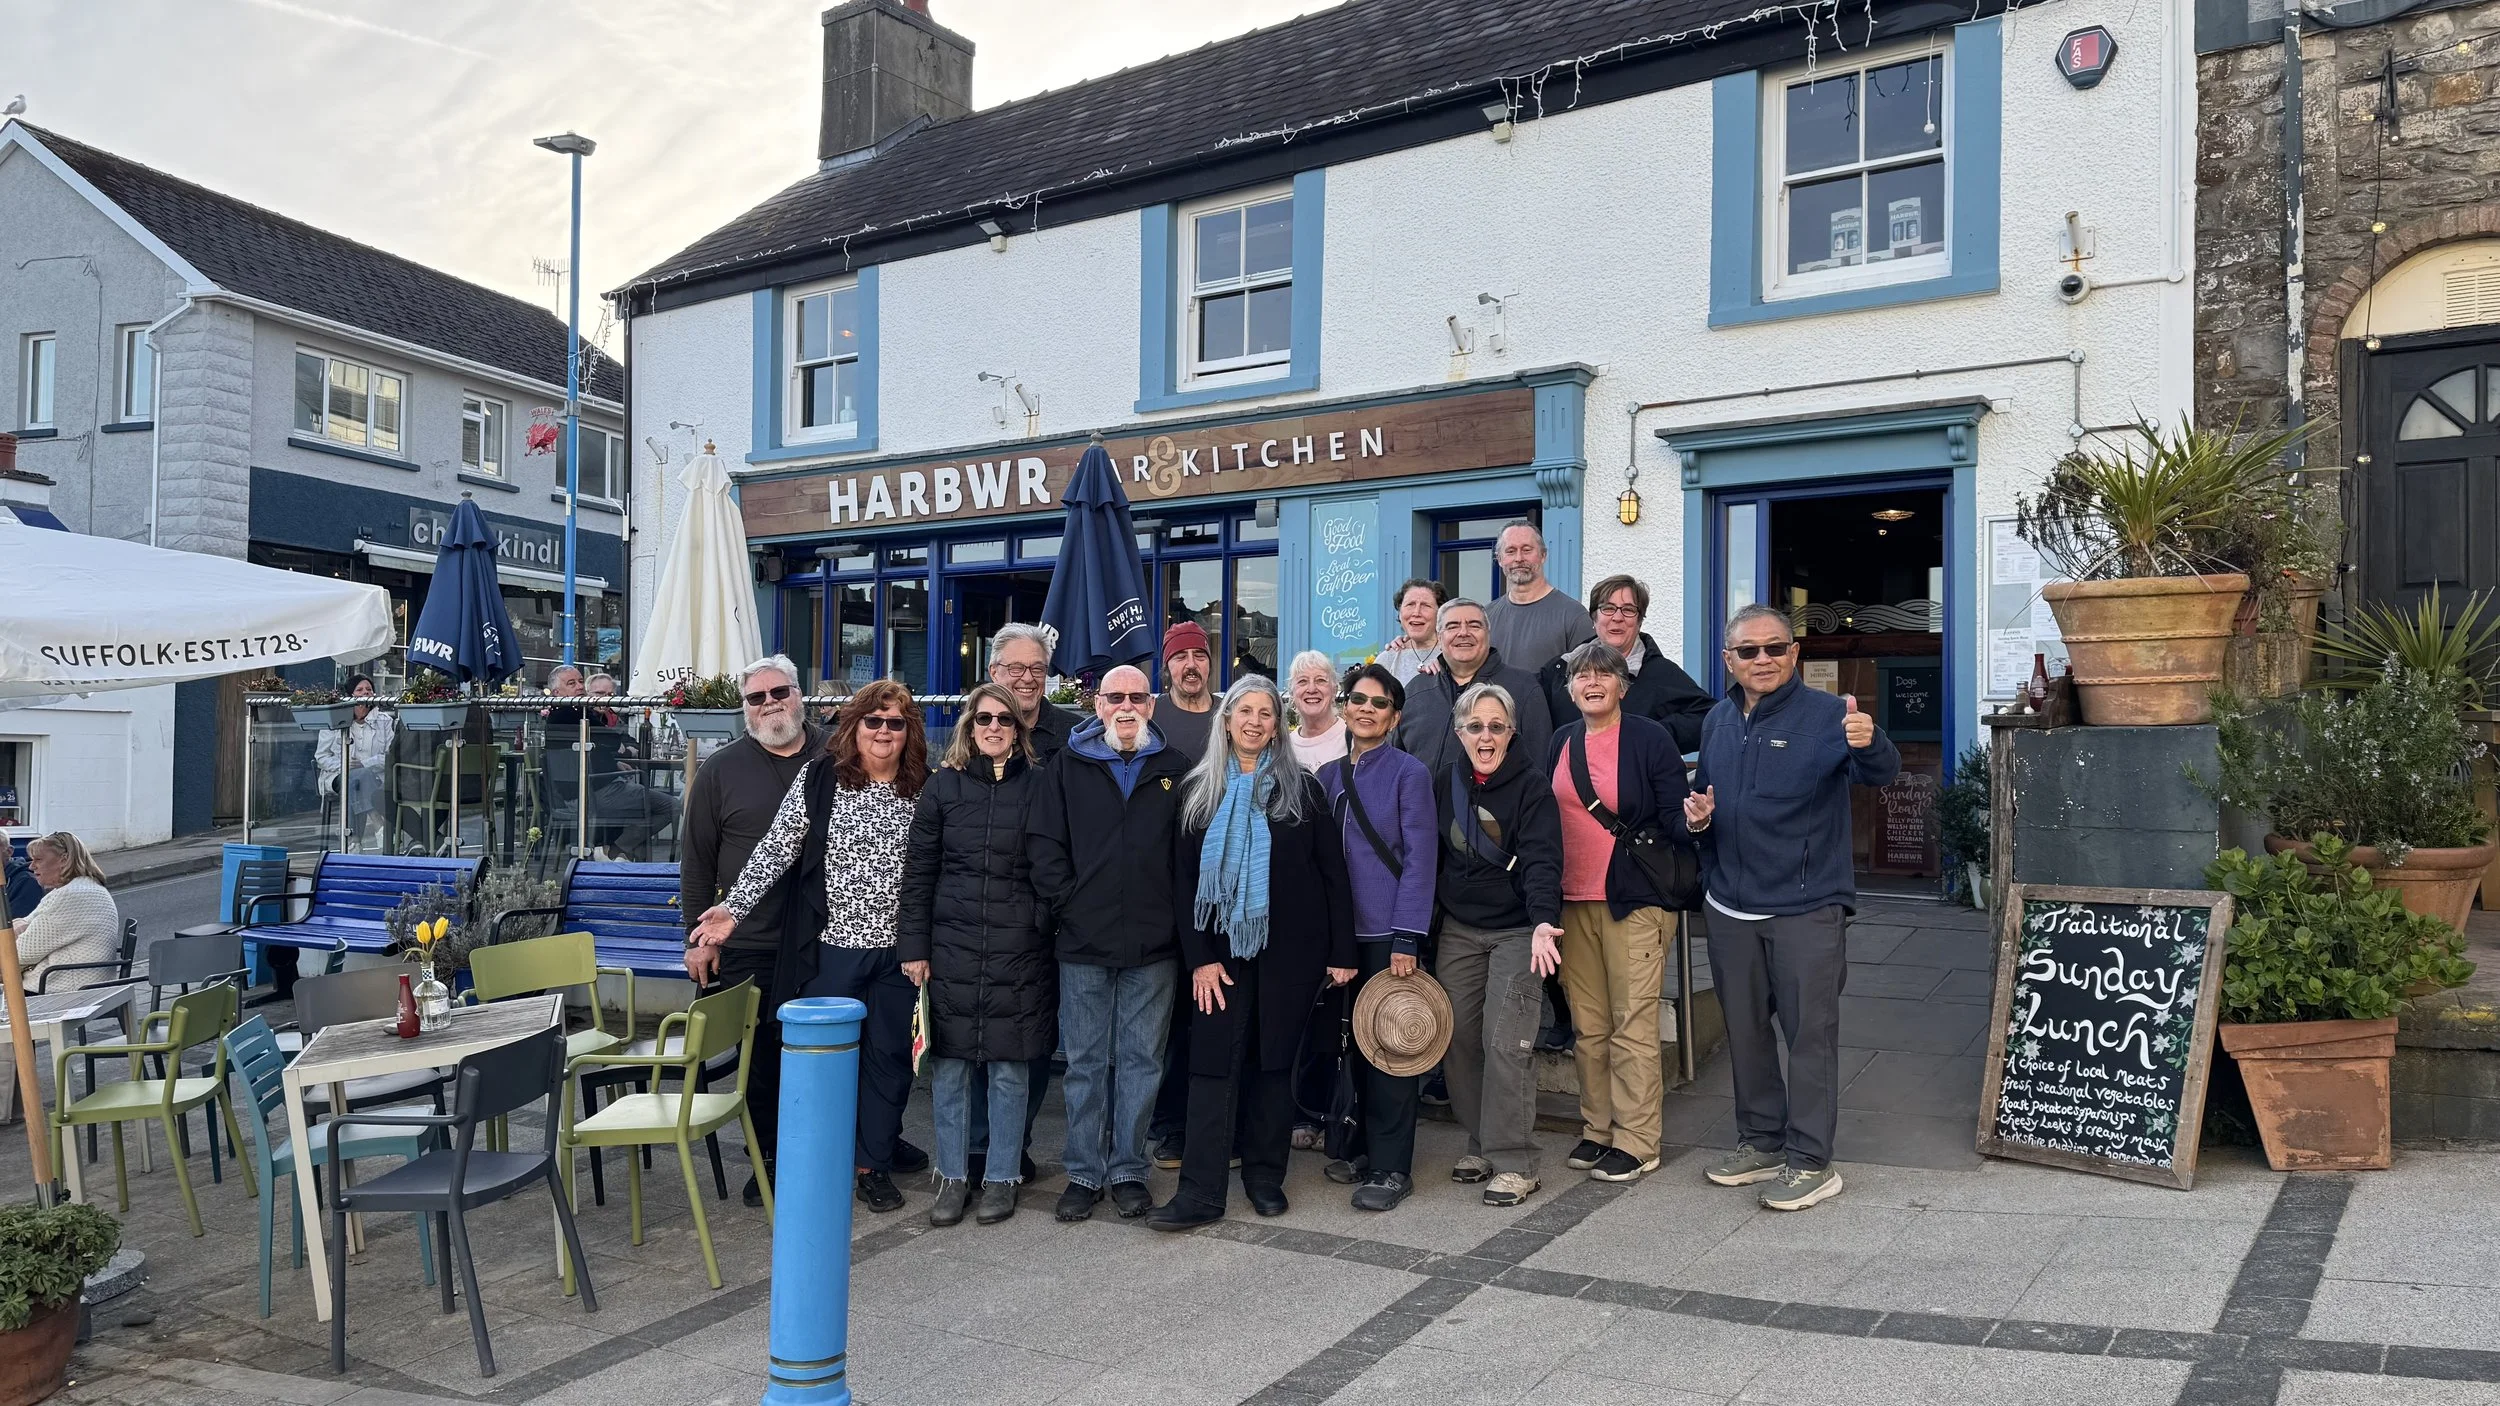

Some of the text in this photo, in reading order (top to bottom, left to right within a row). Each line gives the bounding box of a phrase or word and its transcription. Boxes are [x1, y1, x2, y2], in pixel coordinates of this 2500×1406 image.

[2072, 39, 2082, 68] FAS
[530, 407, 553, 416] WALES
[828, 457, 1051, 525] HARBWR
[1182, 427, 1384, 478] KITCHEN
[1324, 516, 1353, 546] Good
[1328, 523, 1366, 554] Food
[1325, 557, 1351, 577] Local
[1316, 569, 1375, 597] Craft Beer
[1321, 606, 1360, 628] Croeso
[1895, 676, 1917, 688] Dogs
[1879, 784, 1932, 808] Sunday
[1887, 800, 1923, 817] Roast
[2042, 907, 2187, 949] Traditional
[2021, 946, 2186, 1011] Sunday
[2020, 991, 2158, 1069] Lunch
[2057, 1059, 2072, 1084] of
[2076, 1060, 2109, 1080] local
[2036, 1081, 2093, 1104] seasonal
[2094, 1087, 2175, 1112] vegetables
[2085, 1125, 2129, 1150] creamy
[2130, 1136, 2174, 1160] mash
